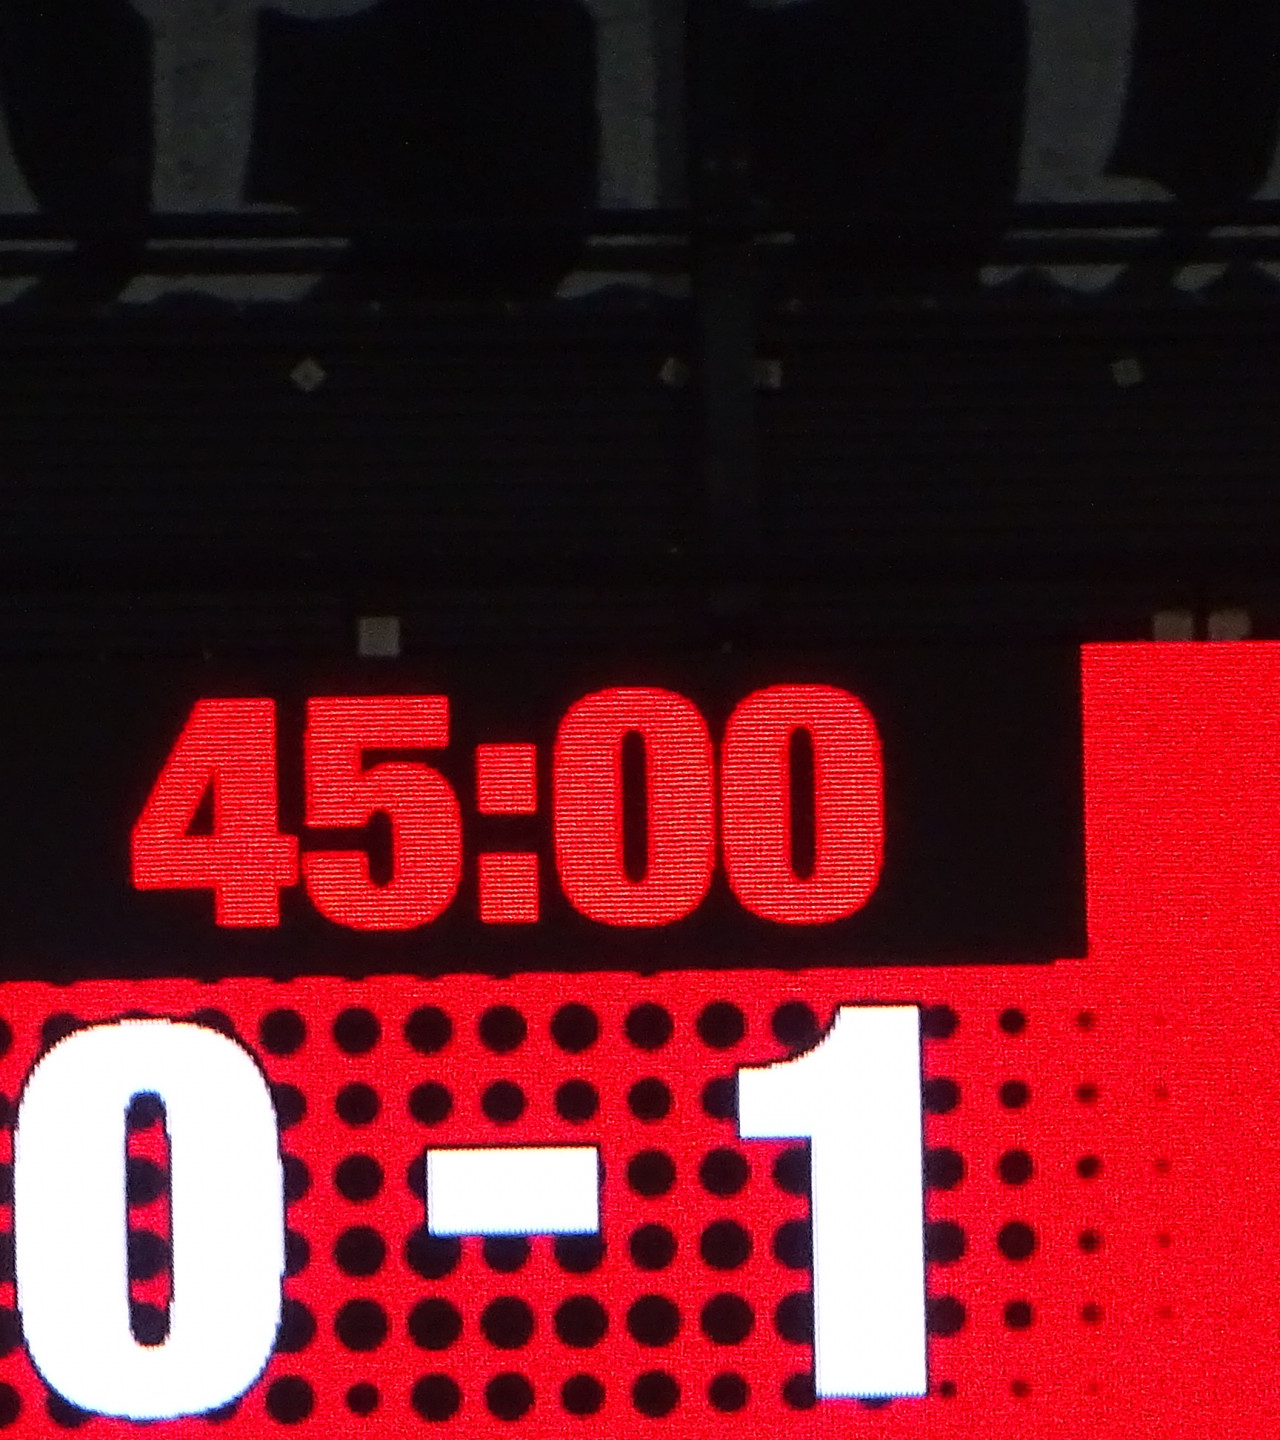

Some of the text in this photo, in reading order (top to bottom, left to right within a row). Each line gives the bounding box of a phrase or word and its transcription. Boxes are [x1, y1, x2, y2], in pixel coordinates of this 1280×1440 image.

[130, 683, 885, 931] 45:00
[13, 1018, 285, 1422] 0
[738, 1005, 928, 1399] 1
